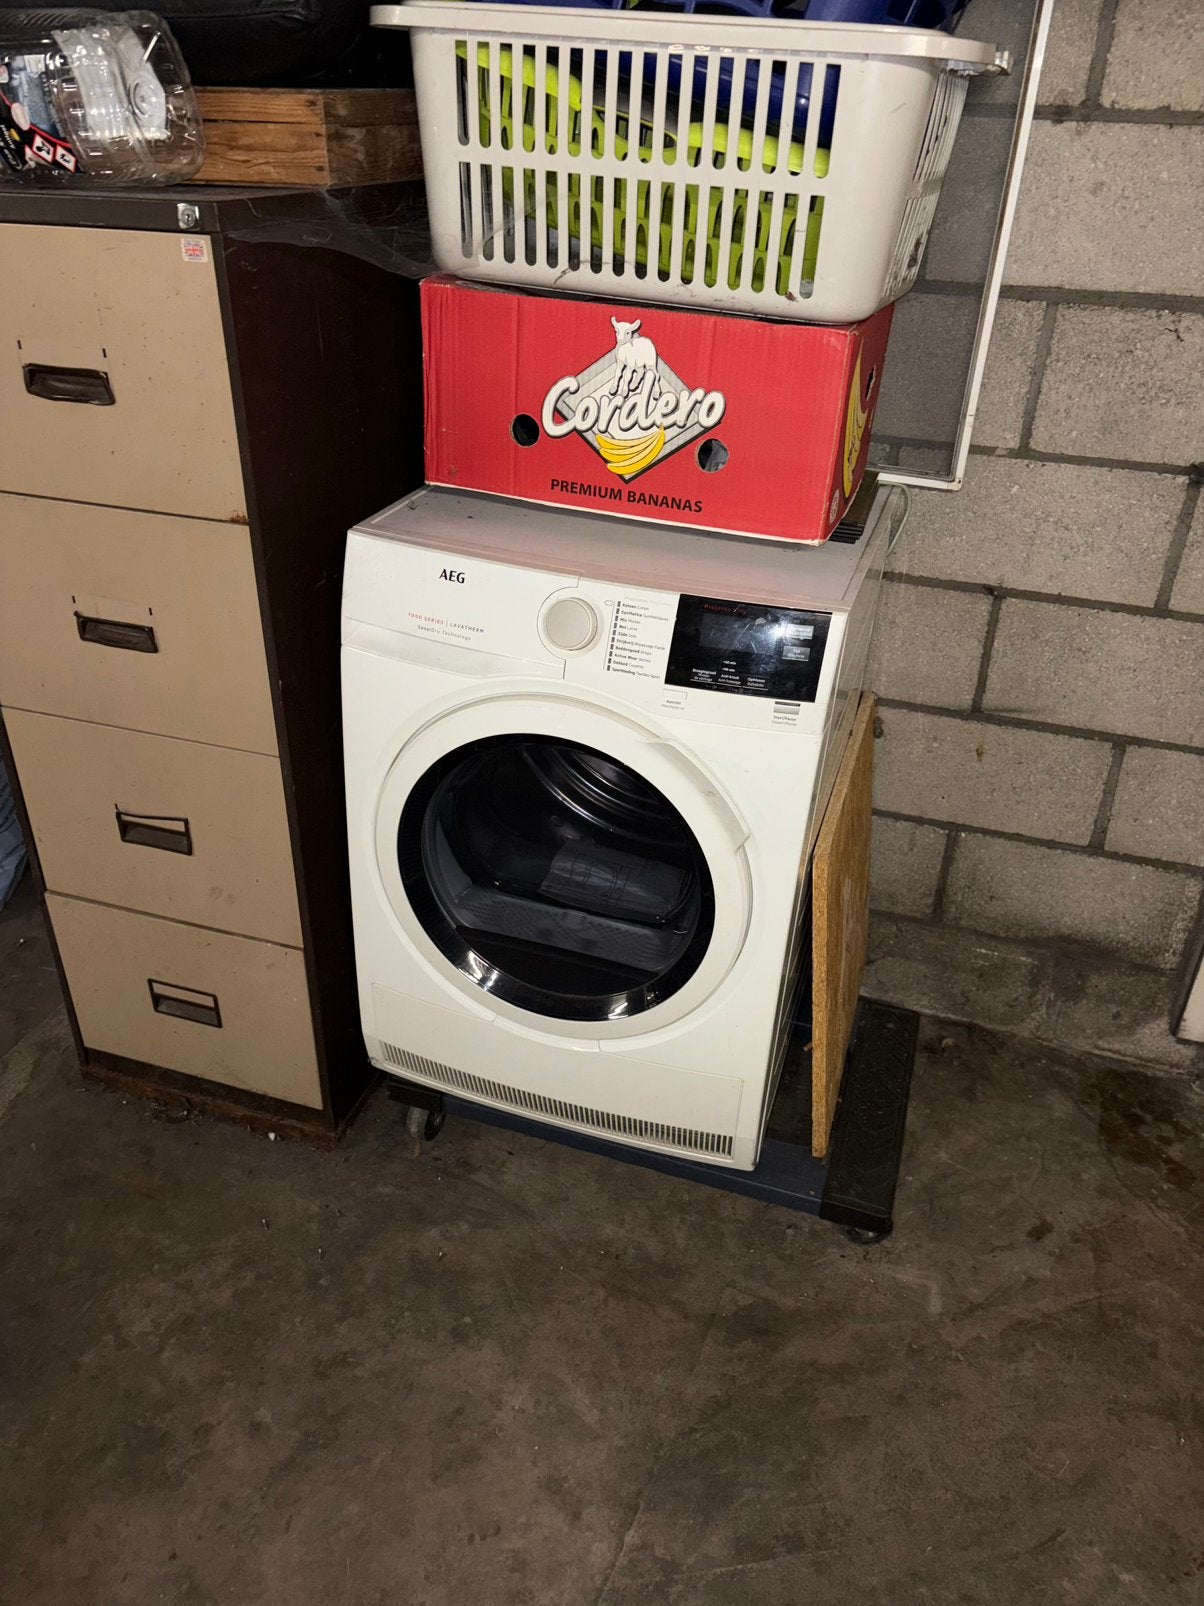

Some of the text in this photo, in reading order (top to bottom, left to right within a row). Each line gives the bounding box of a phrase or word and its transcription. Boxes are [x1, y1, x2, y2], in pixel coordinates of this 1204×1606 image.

[542, 369, 726, 438] Cordero
[550, 478, 703, 513] PREMIUM BANANAS
[438, 568, 466, 584] AEG
[408, 612, 485, 633] 7000 SERIES LAVATHERM
[442, 630, 471, 641] Technology
